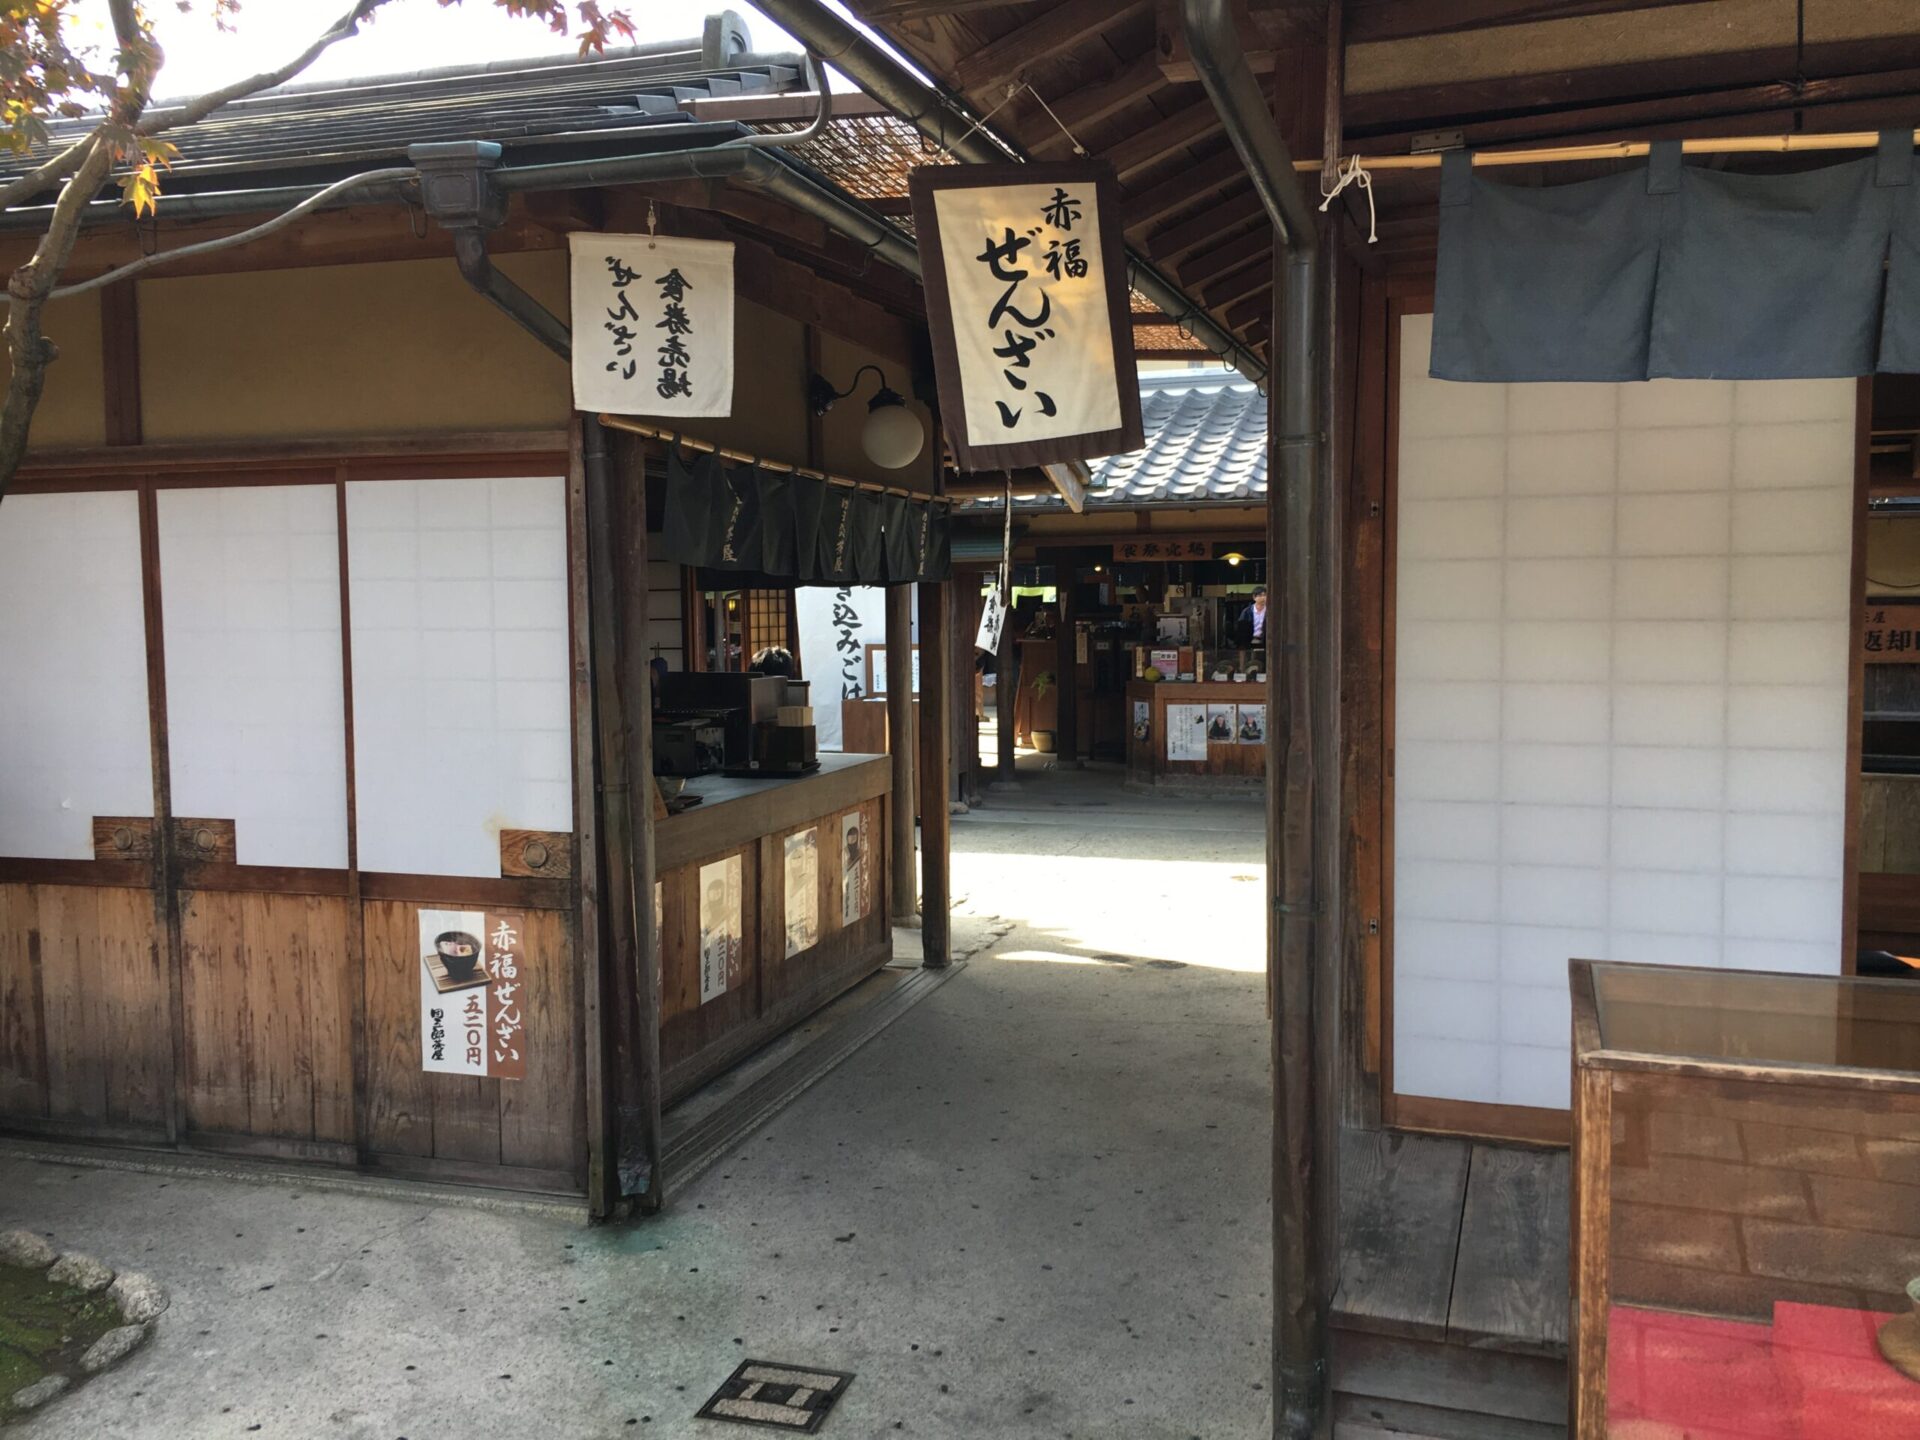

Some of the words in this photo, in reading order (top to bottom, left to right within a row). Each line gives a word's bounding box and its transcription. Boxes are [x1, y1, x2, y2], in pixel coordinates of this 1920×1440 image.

[1040, 187, 1089, 281] 赤福
[976, 227, 1057, 429] ぜんざい
[463, 994, 484, 1067] 五二〇円
[489, 919, 522, 1063] 赤福ぜんざい
